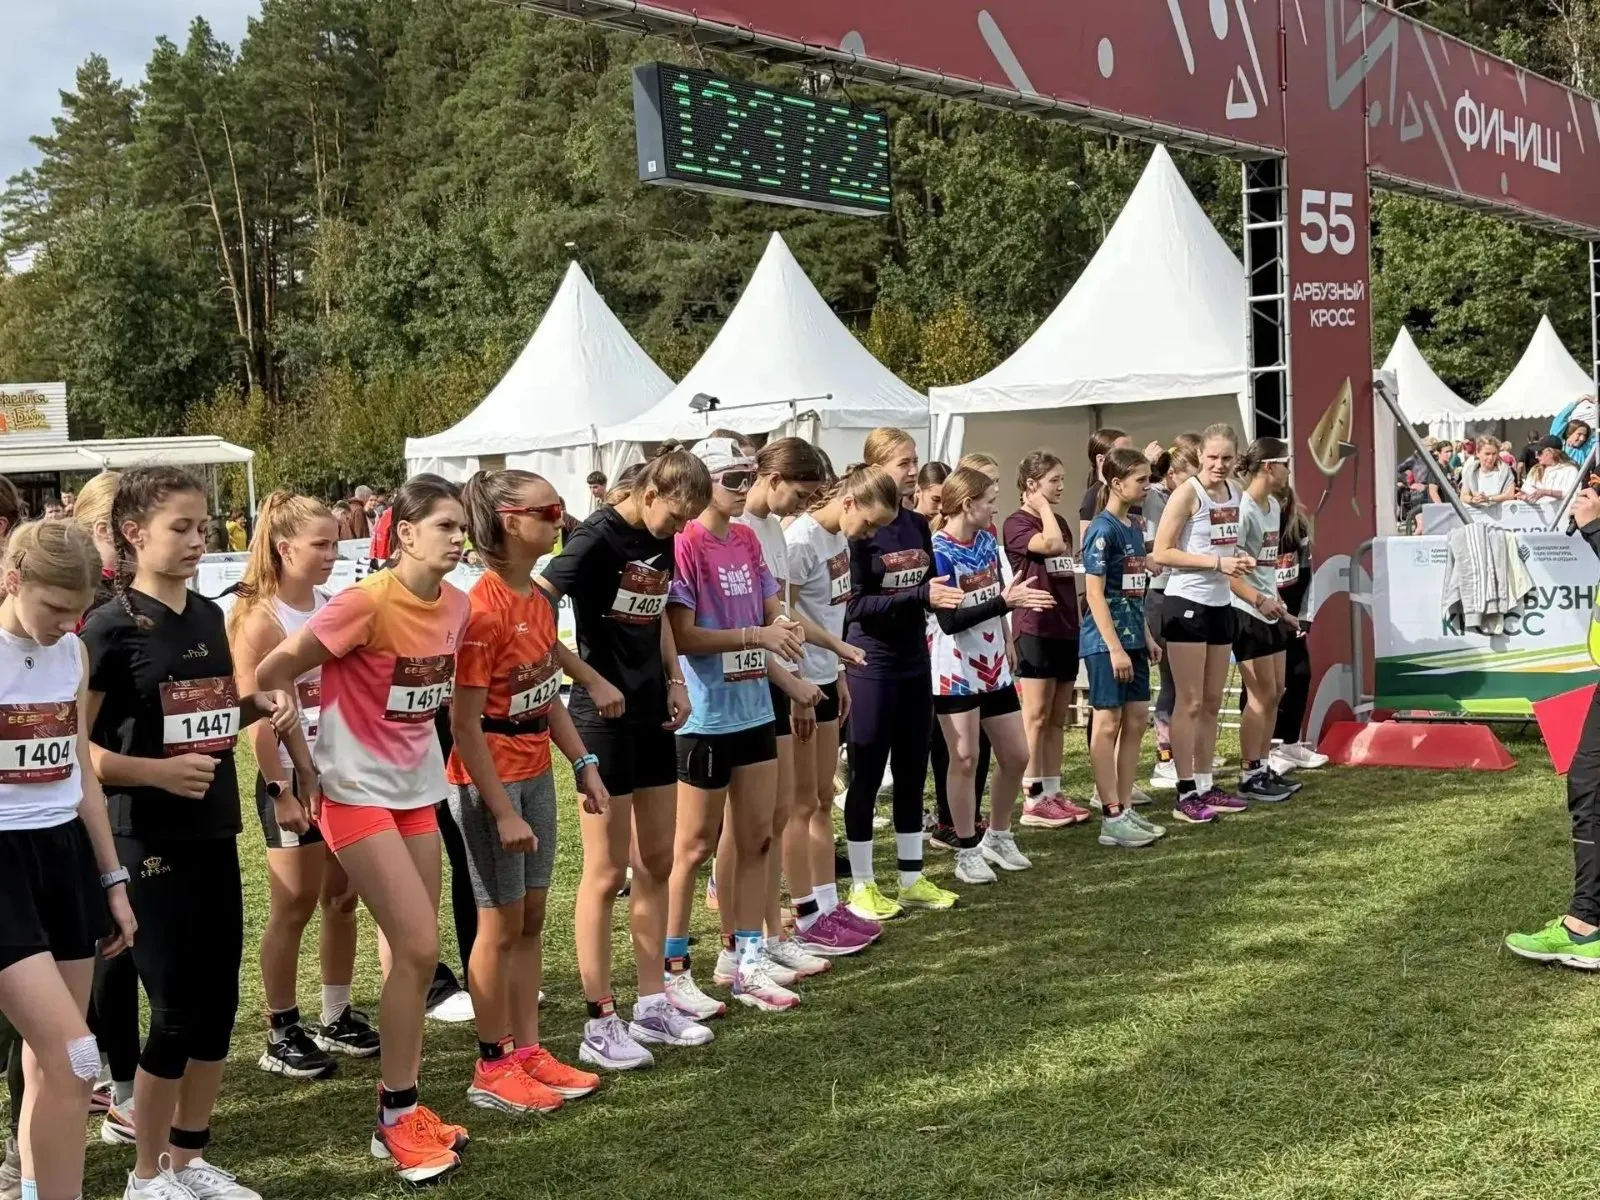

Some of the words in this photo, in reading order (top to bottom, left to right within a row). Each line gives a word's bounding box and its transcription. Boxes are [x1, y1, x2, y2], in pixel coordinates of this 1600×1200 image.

[1454, 89, 1561, 174] ФИНИШ
[1300, 188, 1356, 256] 55
[1292, 279, 1366, 303] АРБУЗНЫЙ
[1309, 308, 1357, 328] КРОСС
[1219, 525, 1239, 537] 144
[894, 570, 923, 587] 1448
[629, 596, 662, 614] 1403
[523, 678, 558, 710] 1422
[181, 712, 232, 740] 1447
[14, 740, 71, 768] 1404
